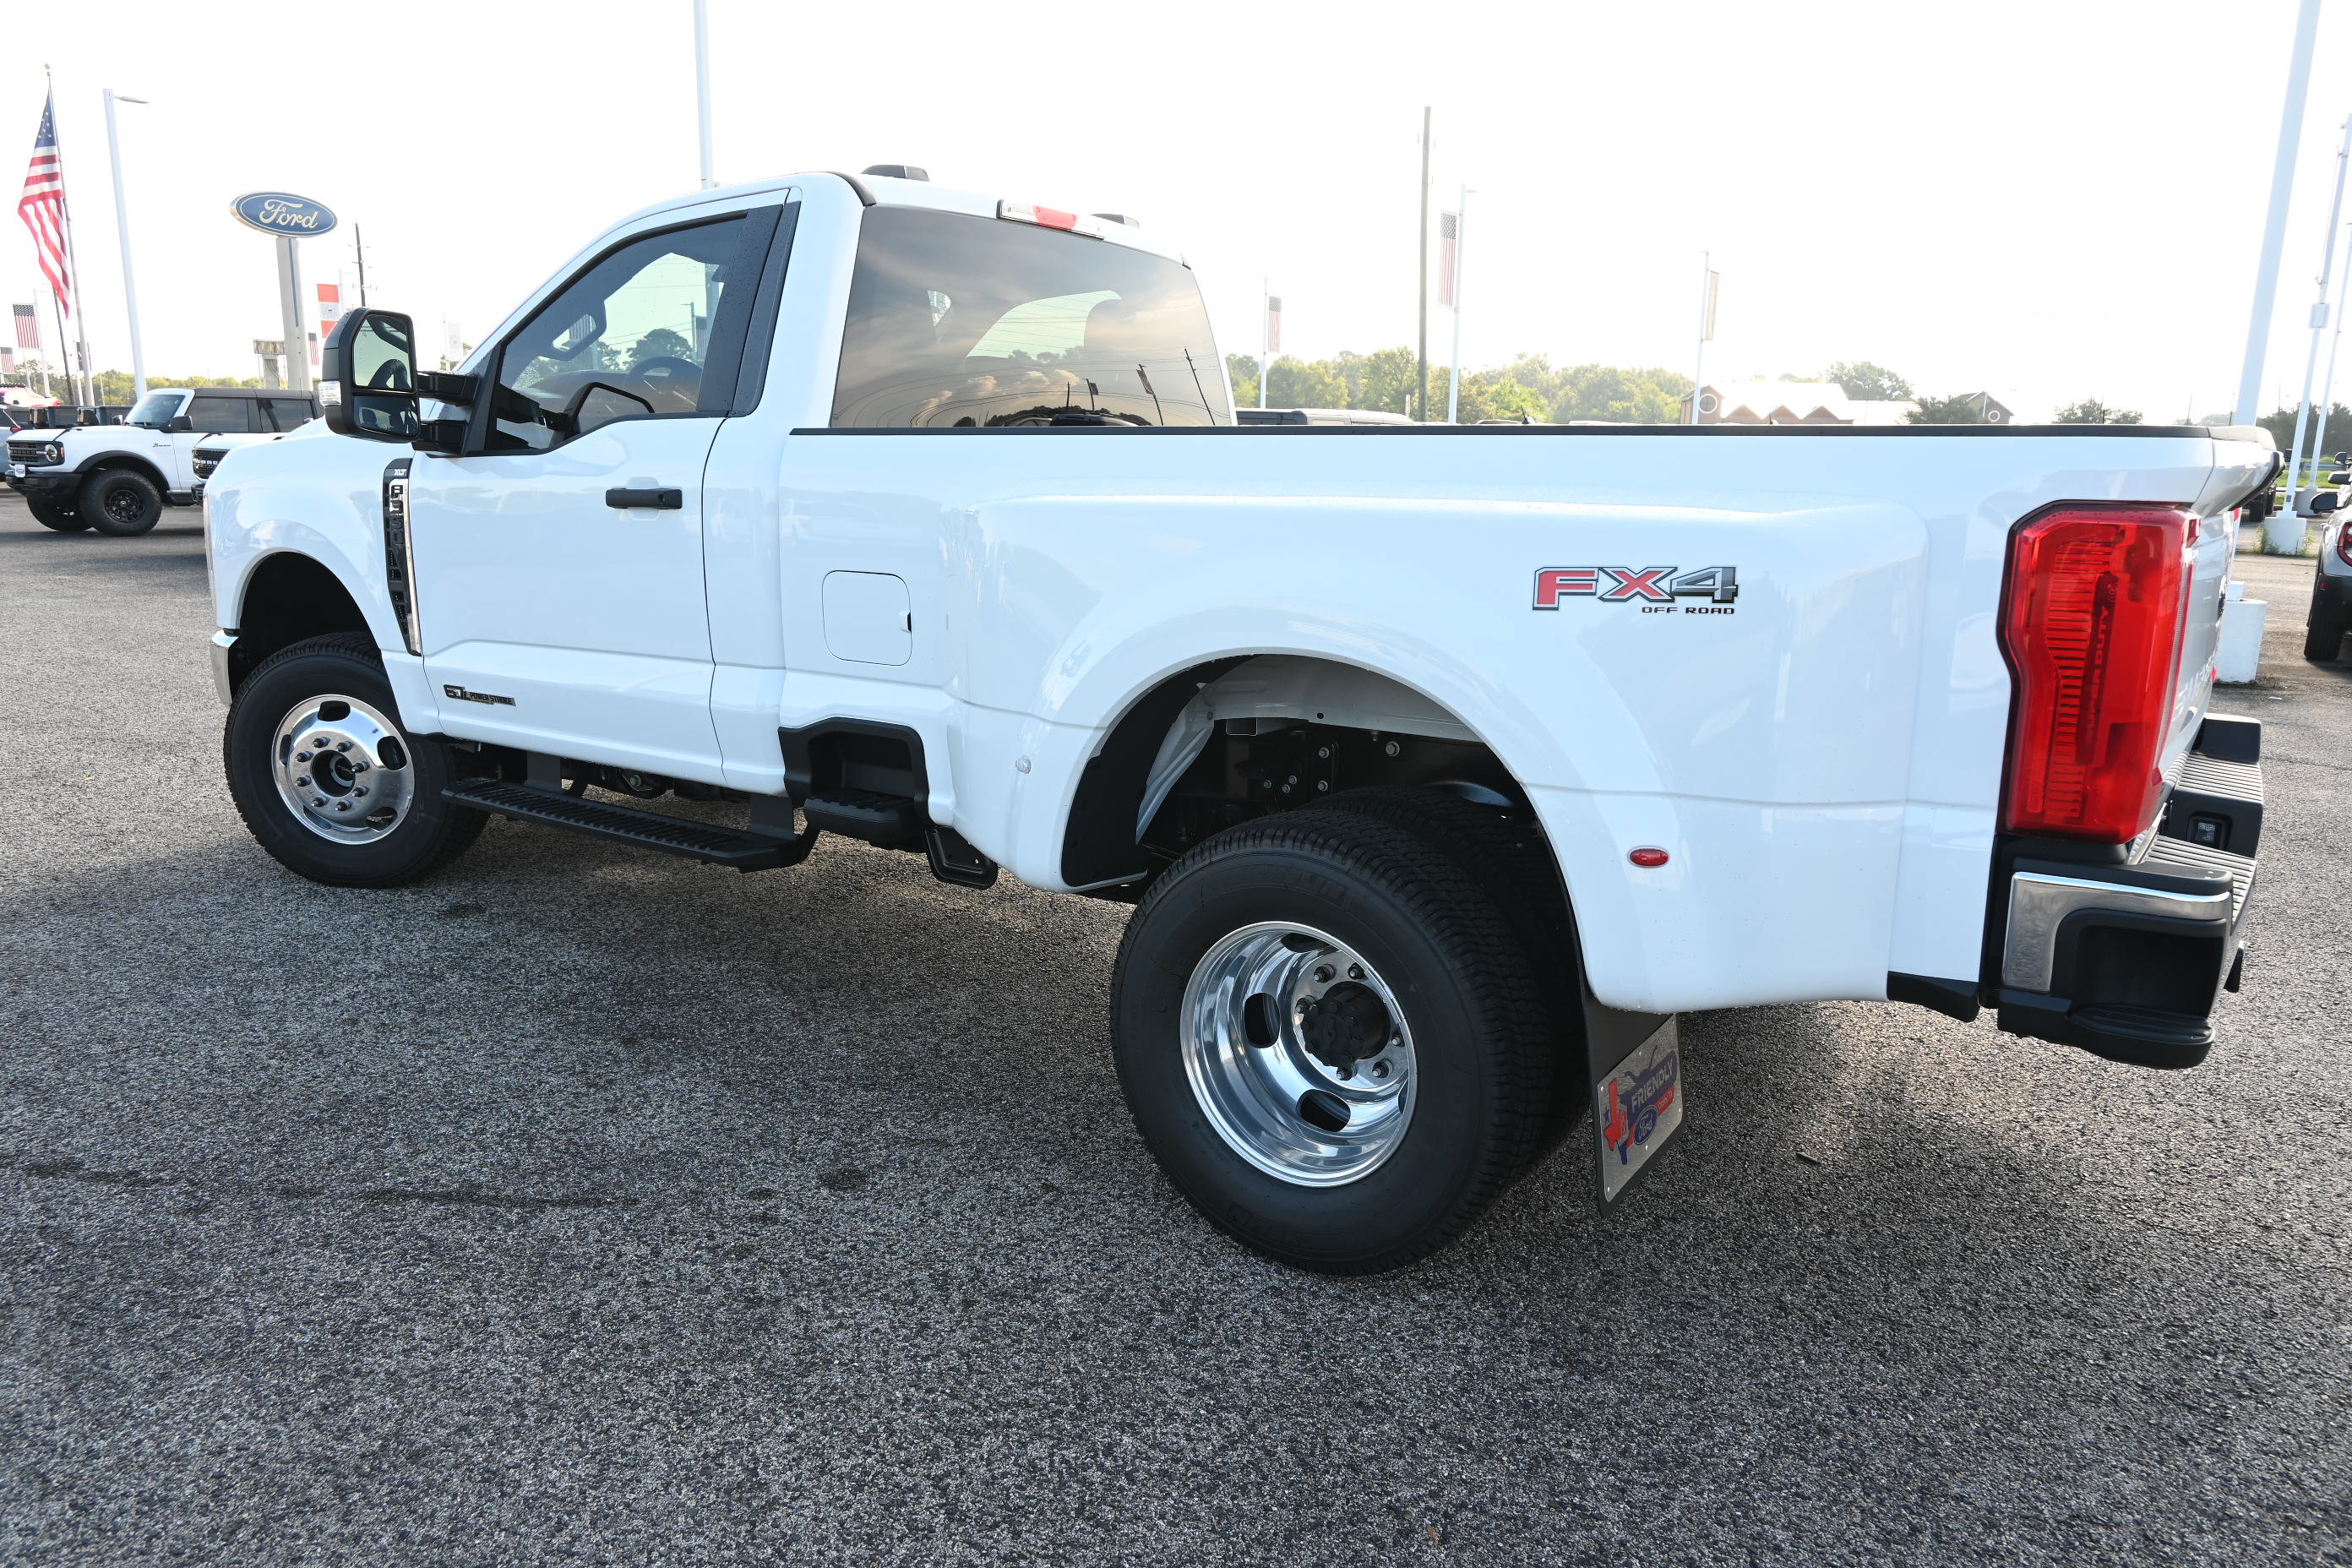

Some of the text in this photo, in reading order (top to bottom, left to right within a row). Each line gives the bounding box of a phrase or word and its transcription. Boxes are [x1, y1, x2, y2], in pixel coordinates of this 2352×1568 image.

[259, 199, 318, 229] Ford
[394, 468, 407, 476] XLT
[1532, 566, 1739, 611] FX4
[1685, 607, 1735, 615] ROAD
[2094, 606, 2110, 666] DUTY
[1631, 1058, 1673, 1113] FRIENDLY
[1638, 1113, 1653, 1141] Ford
